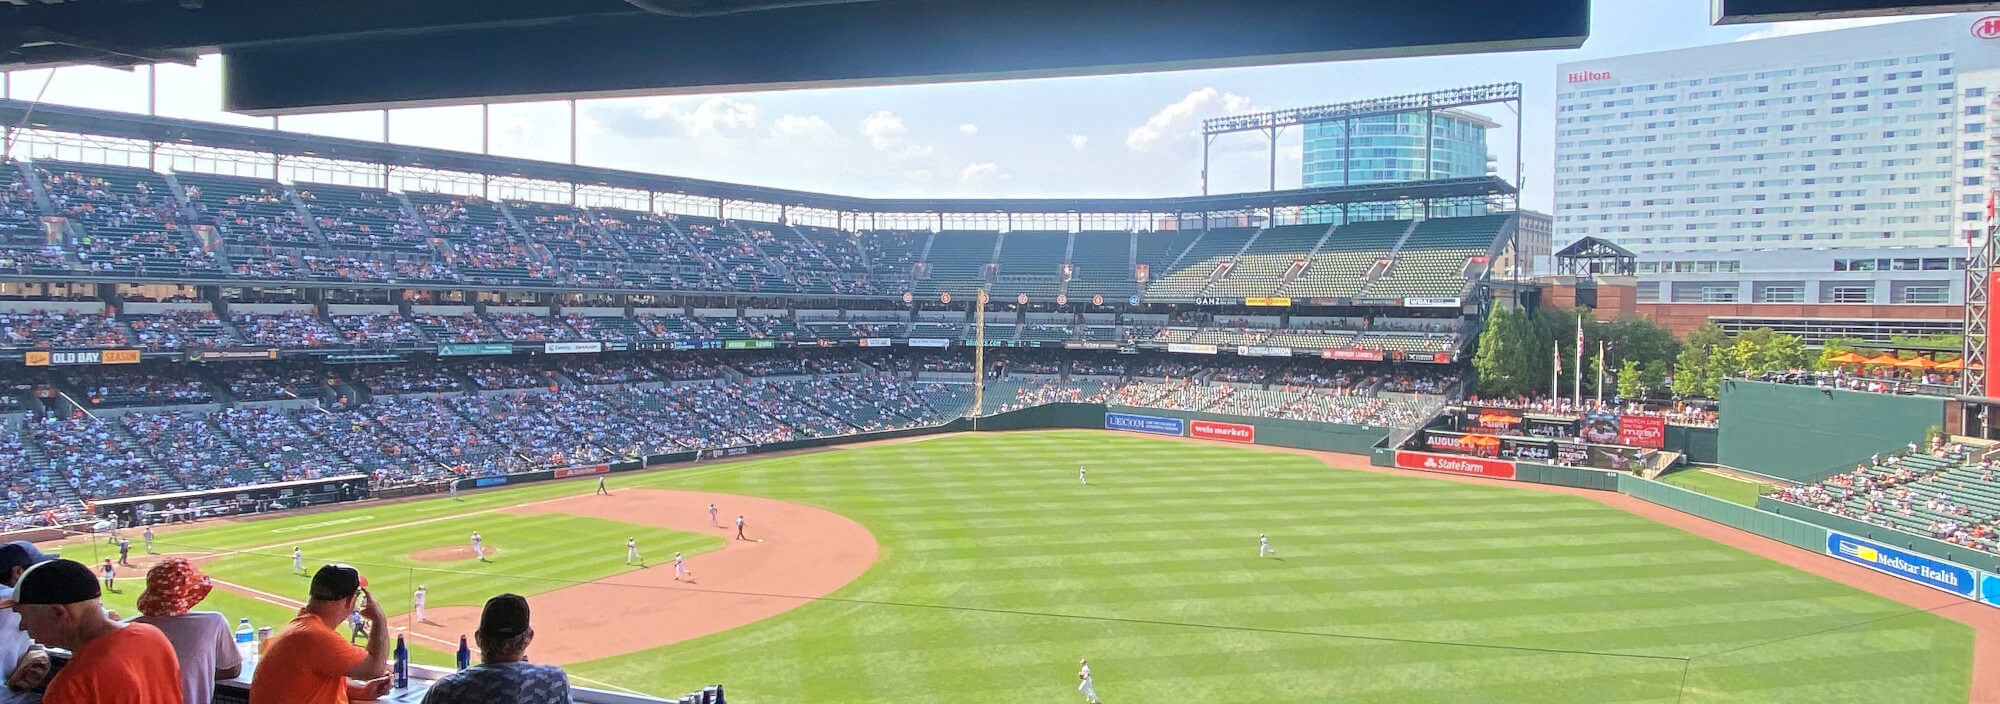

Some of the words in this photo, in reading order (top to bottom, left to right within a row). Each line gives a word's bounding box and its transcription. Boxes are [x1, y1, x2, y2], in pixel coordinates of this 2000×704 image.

[1568, 70, 1611, 83] Hilton
[1195, 297, 1220, 305] GANZ
[53, 352, 76, 364] OLD
[77, 352, 100, 363] BAY
[104, 351, 137, 362] SEASON
[1109, 415, 1145, 428] LECOM
[1195, 425, 1214, 434] weis
[1214, 427, 1249, 437] markets
[1878, 553, 1920, 574] MedStar
[1921, 565, 1959, 586] Health
